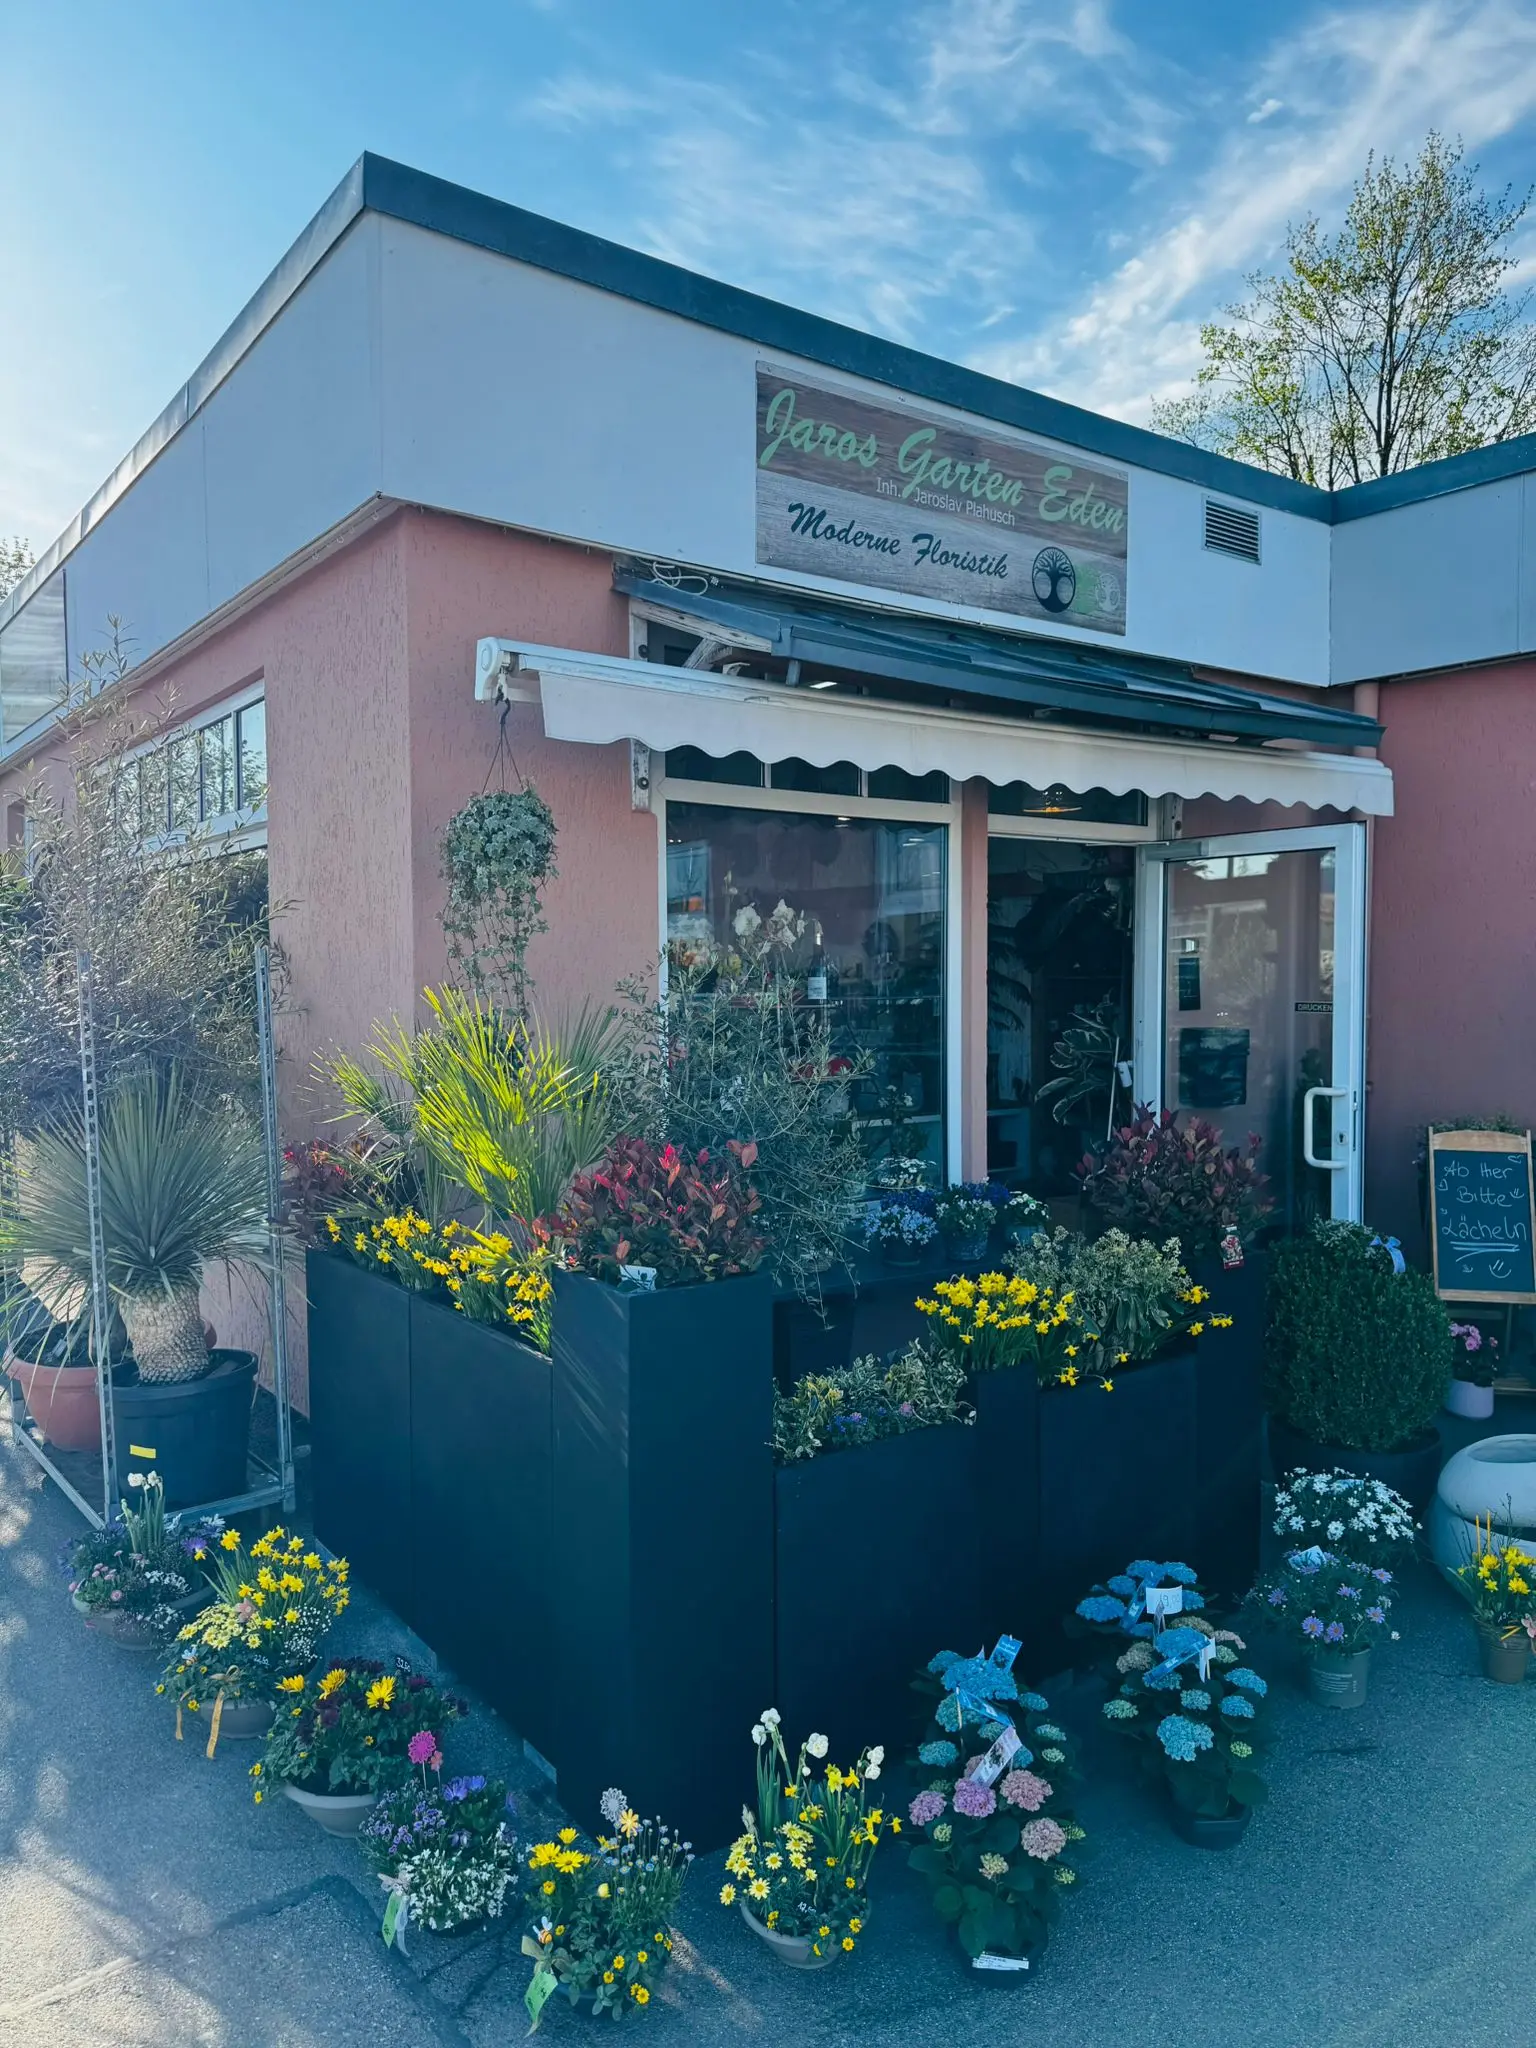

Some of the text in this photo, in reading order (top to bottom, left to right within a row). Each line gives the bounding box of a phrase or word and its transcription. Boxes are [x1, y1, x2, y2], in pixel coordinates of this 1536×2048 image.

[760, 388, 1125, 534] Jaros Garten Eden
[876, 477, 1016, 527] Inh. Jaroslav Plahusch
[788, 502, 1009, 579] Moderne Floristik
[1444, 1160, 1470, 1178] Ab
[1456, 1186, 1513, 1207] Bitte
[1441, 1215, 1527, 1241] Lächeln
